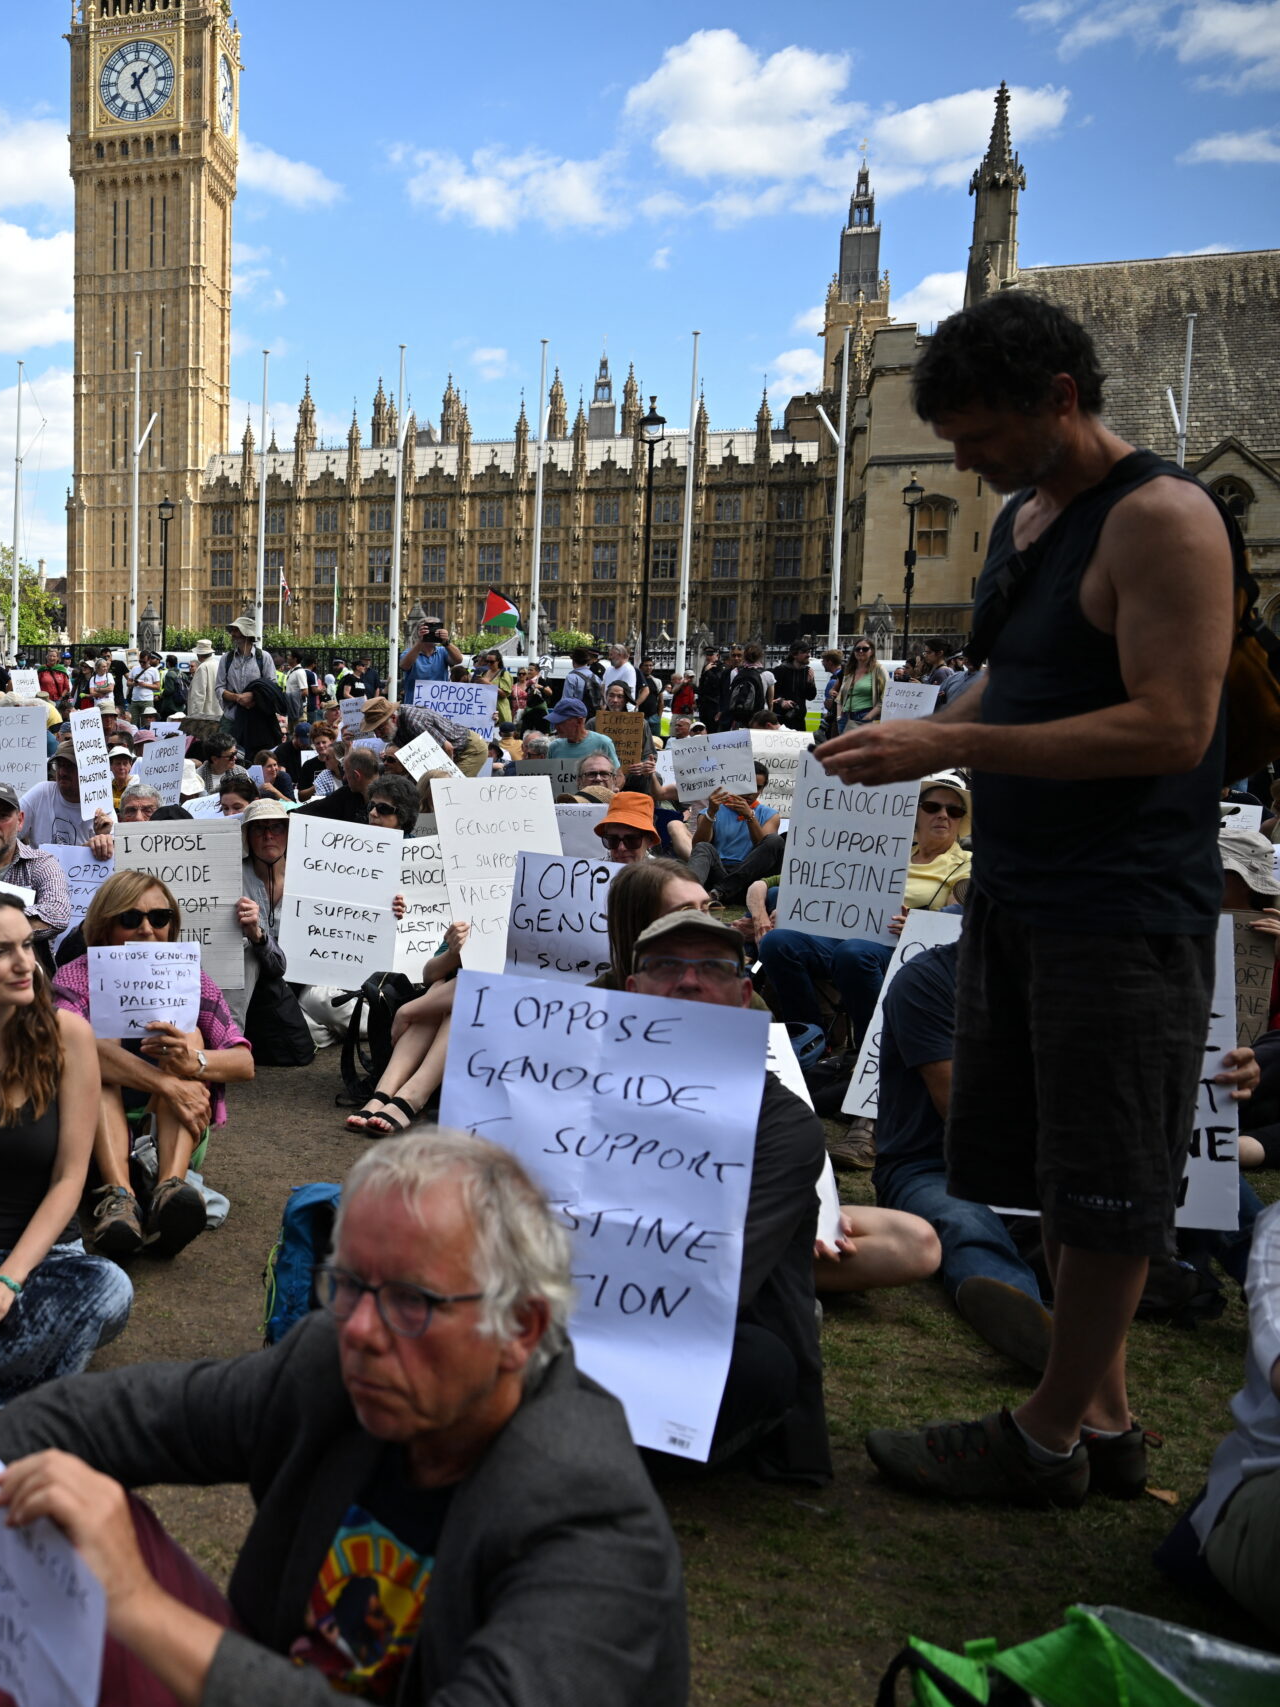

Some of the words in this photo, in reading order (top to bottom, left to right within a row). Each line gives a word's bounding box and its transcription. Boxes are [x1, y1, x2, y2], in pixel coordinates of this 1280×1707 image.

[415, 685, 423, 700] I
[430, 684, 484, 704] OPPOSE
[885, 687, 891, 697] I
[477, 705, 487, 715] I
[79, 718, 101, 730] OPPOSE
[86, 754, 109, 767] SUPPORT
[154, 745, 179, 759] OPPOSE
[79, 770, 108, 784] PALESTINE
[144, 763, 179, 777] GENOCIDE
[679, 763, 726, 777] SUPPORT
[803, 759, 808, 778] I
[720, 772, 752, 785] ACTION
[441, 786, 463, 806] I
[479, 784, 539, 802] OPPOSE
[806, 787, 916, 817] GENOCIDE
[455, 817, 537, 836] GENOCIDE
[124, 836, 132, 853] I
[140, 834, 206, 852] OPPOSE
[304, 823, 309, 848] I
[321, 831, 391, 854] OPPOSE
[793, 826, 797, 846] I
[805, 826, 907, 858] SUPPORT
[401, 843, 442, 862] PPOS
[451, 855, 467, 870] I
[476, 852, 518, 868] SUPPO
[67, 864, 114, 879] OPPO
[125, 865, 211, 883] NOCIDE
[303, 857, 384, 880] GENOCIDE
[400, 869, 447, 886] ENOCI
[789, 858, 907, 895] PALESTINE
[520, 856, 527, 898] I
[538, 859, 610, 901] OPP
[177, 896, 219, 913] PORT
[459, 883, 513, 907] PALEST
[295, 899, 302, 917] I
[313, 903, 381, 923] SUPPORT
[405, 902, 451, 916] UPPORT
[513, 903, 609, 934] GENO
[789, 897, 884, 935] ACTION
[307, 924, 378, 944] PALESTINE
[110, 951, 149, 961] OPPOSE
[154, 952, 200, 962] GENOCIDE
[309, 948, 364, 965] ACTION
[538, 953, 611, 977] SUPP
[100, 978, 104, 991] I
[114, 980, 173, 990] SUPPORT
[470, 986, 490, 1028] I
[514, 996, 683, 1045] OPPOSE
[467, 1048, 716, 1114] GENOCIDE
[543, 1127, 745, 1183] SUPPORT
[552, 1199, 734, 1264] STINE
